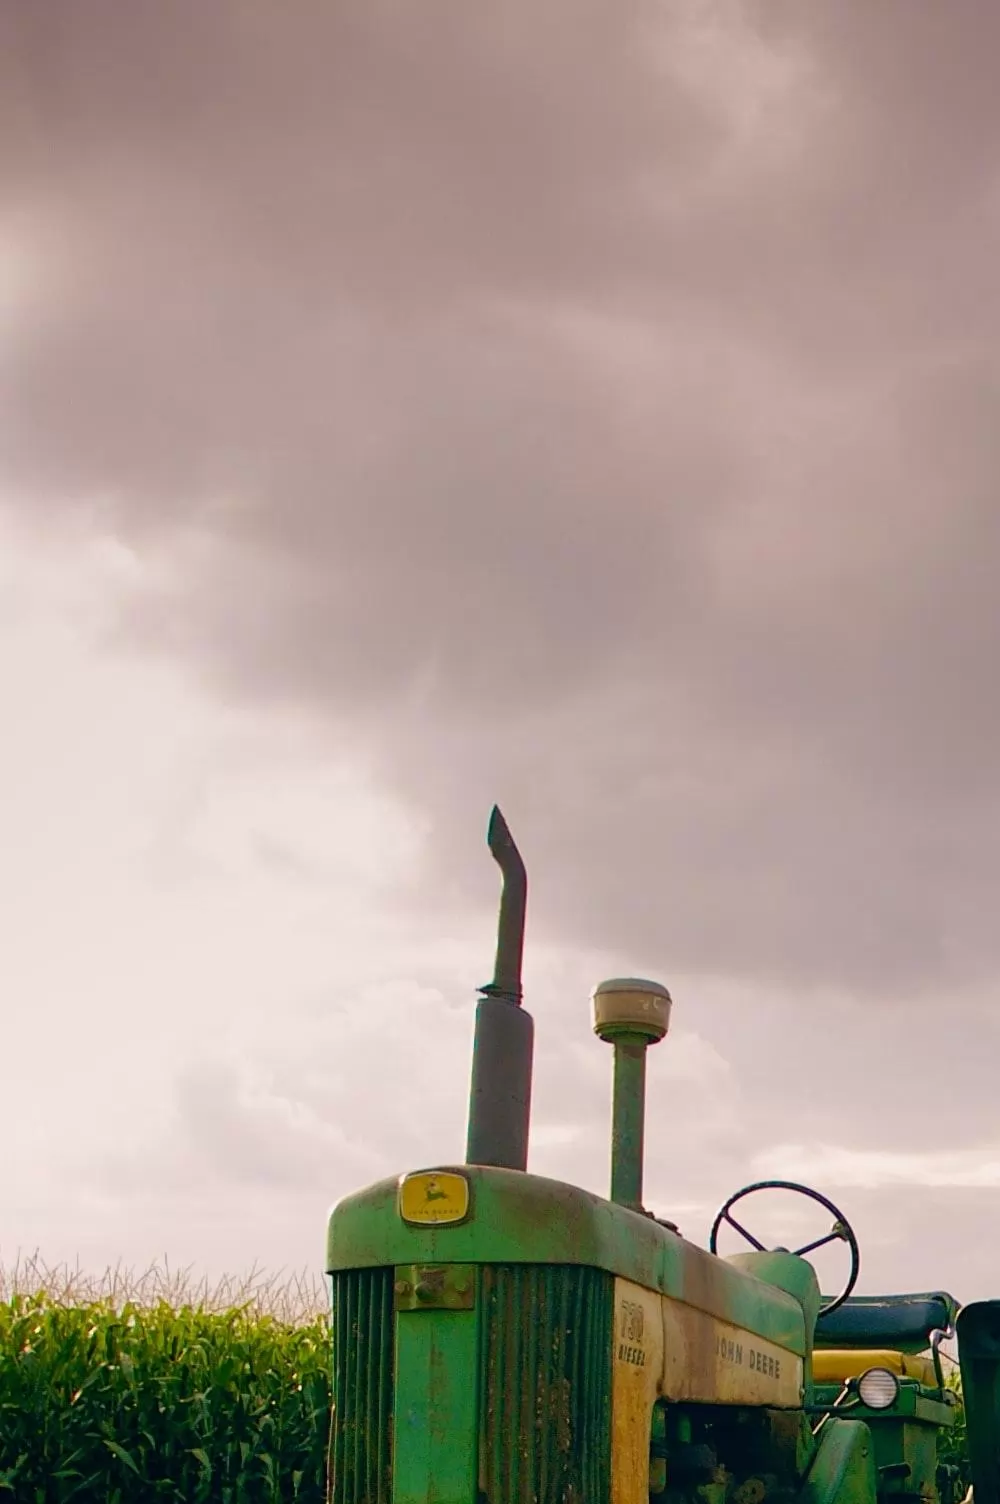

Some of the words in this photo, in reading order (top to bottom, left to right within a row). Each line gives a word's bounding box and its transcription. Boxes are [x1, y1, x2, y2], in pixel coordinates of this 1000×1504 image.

[618, 1344, 646, 1367] DIESEL
[715, 1335, 743, 1365] JOHN
[749, 1349, 780, 1379] DEERE
